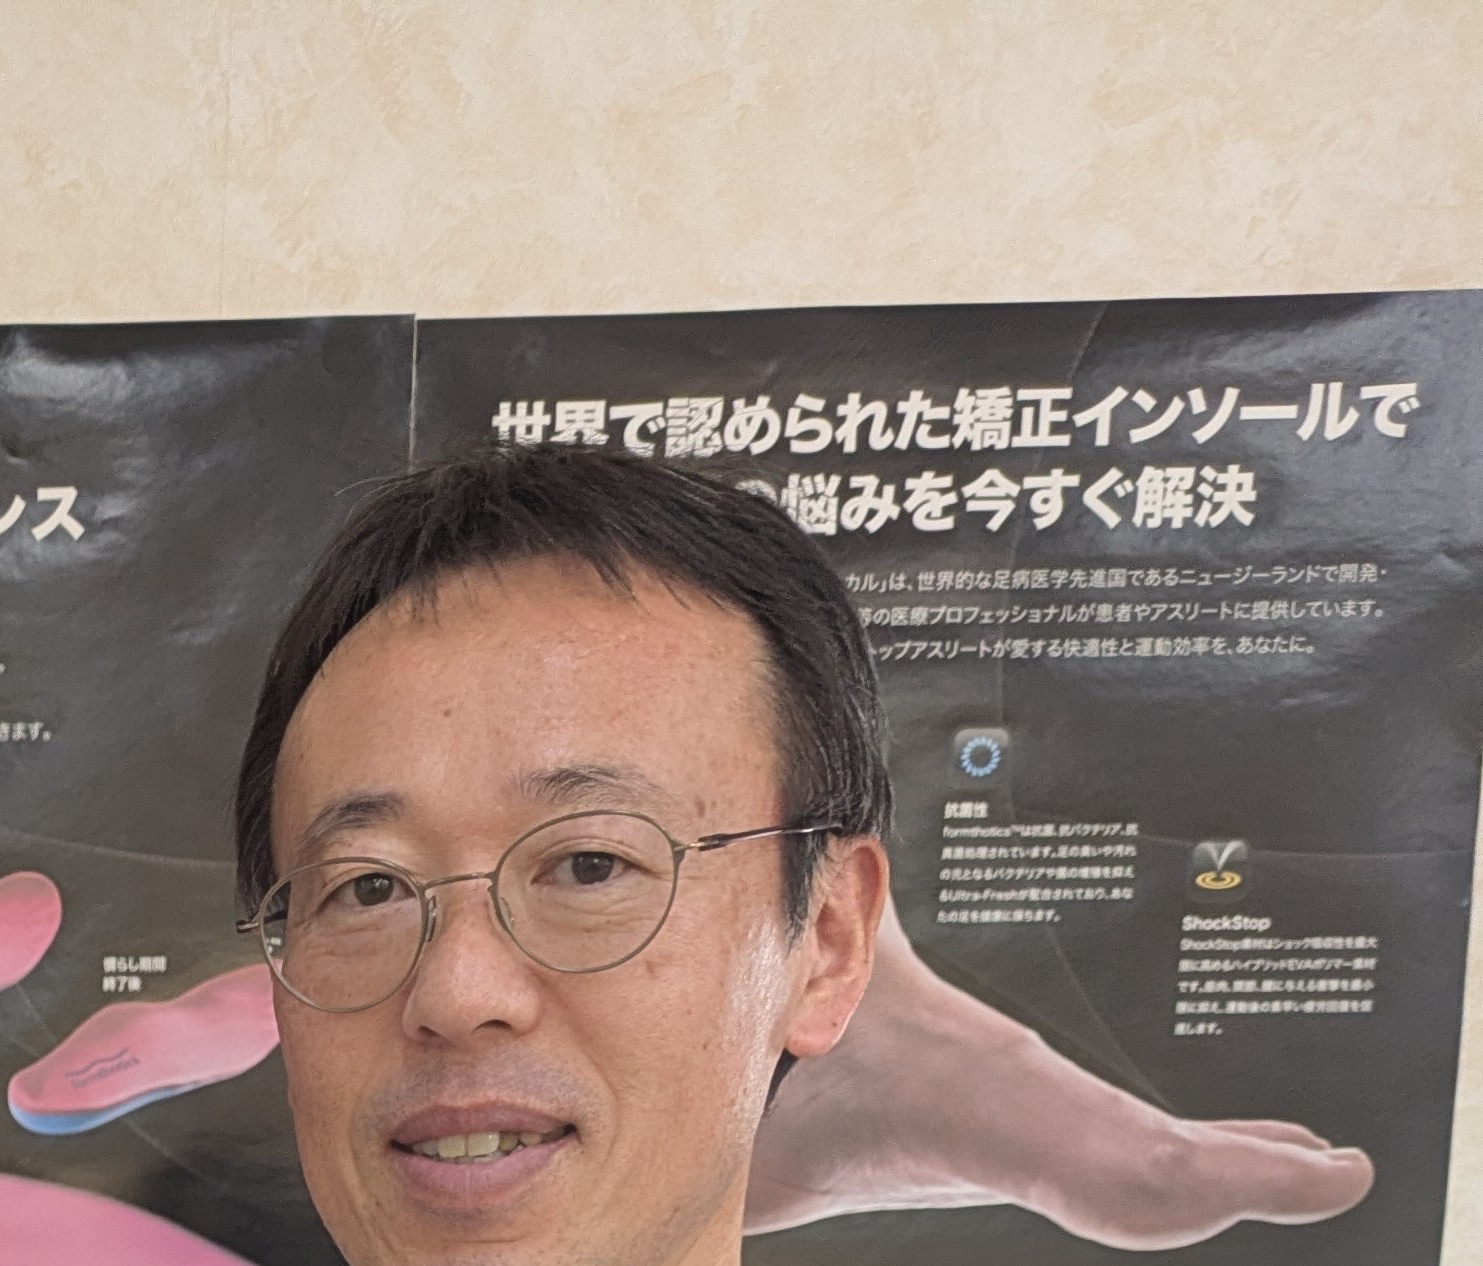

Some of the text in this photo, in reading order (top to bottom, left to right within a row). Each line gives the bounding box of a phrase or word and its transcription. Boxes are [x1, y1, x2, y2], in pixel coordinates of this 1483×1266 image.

[491, 381, 1420, 458] 世界で認められた矯正インソールで
[1182, 915, 1272, 932] ShockStop
